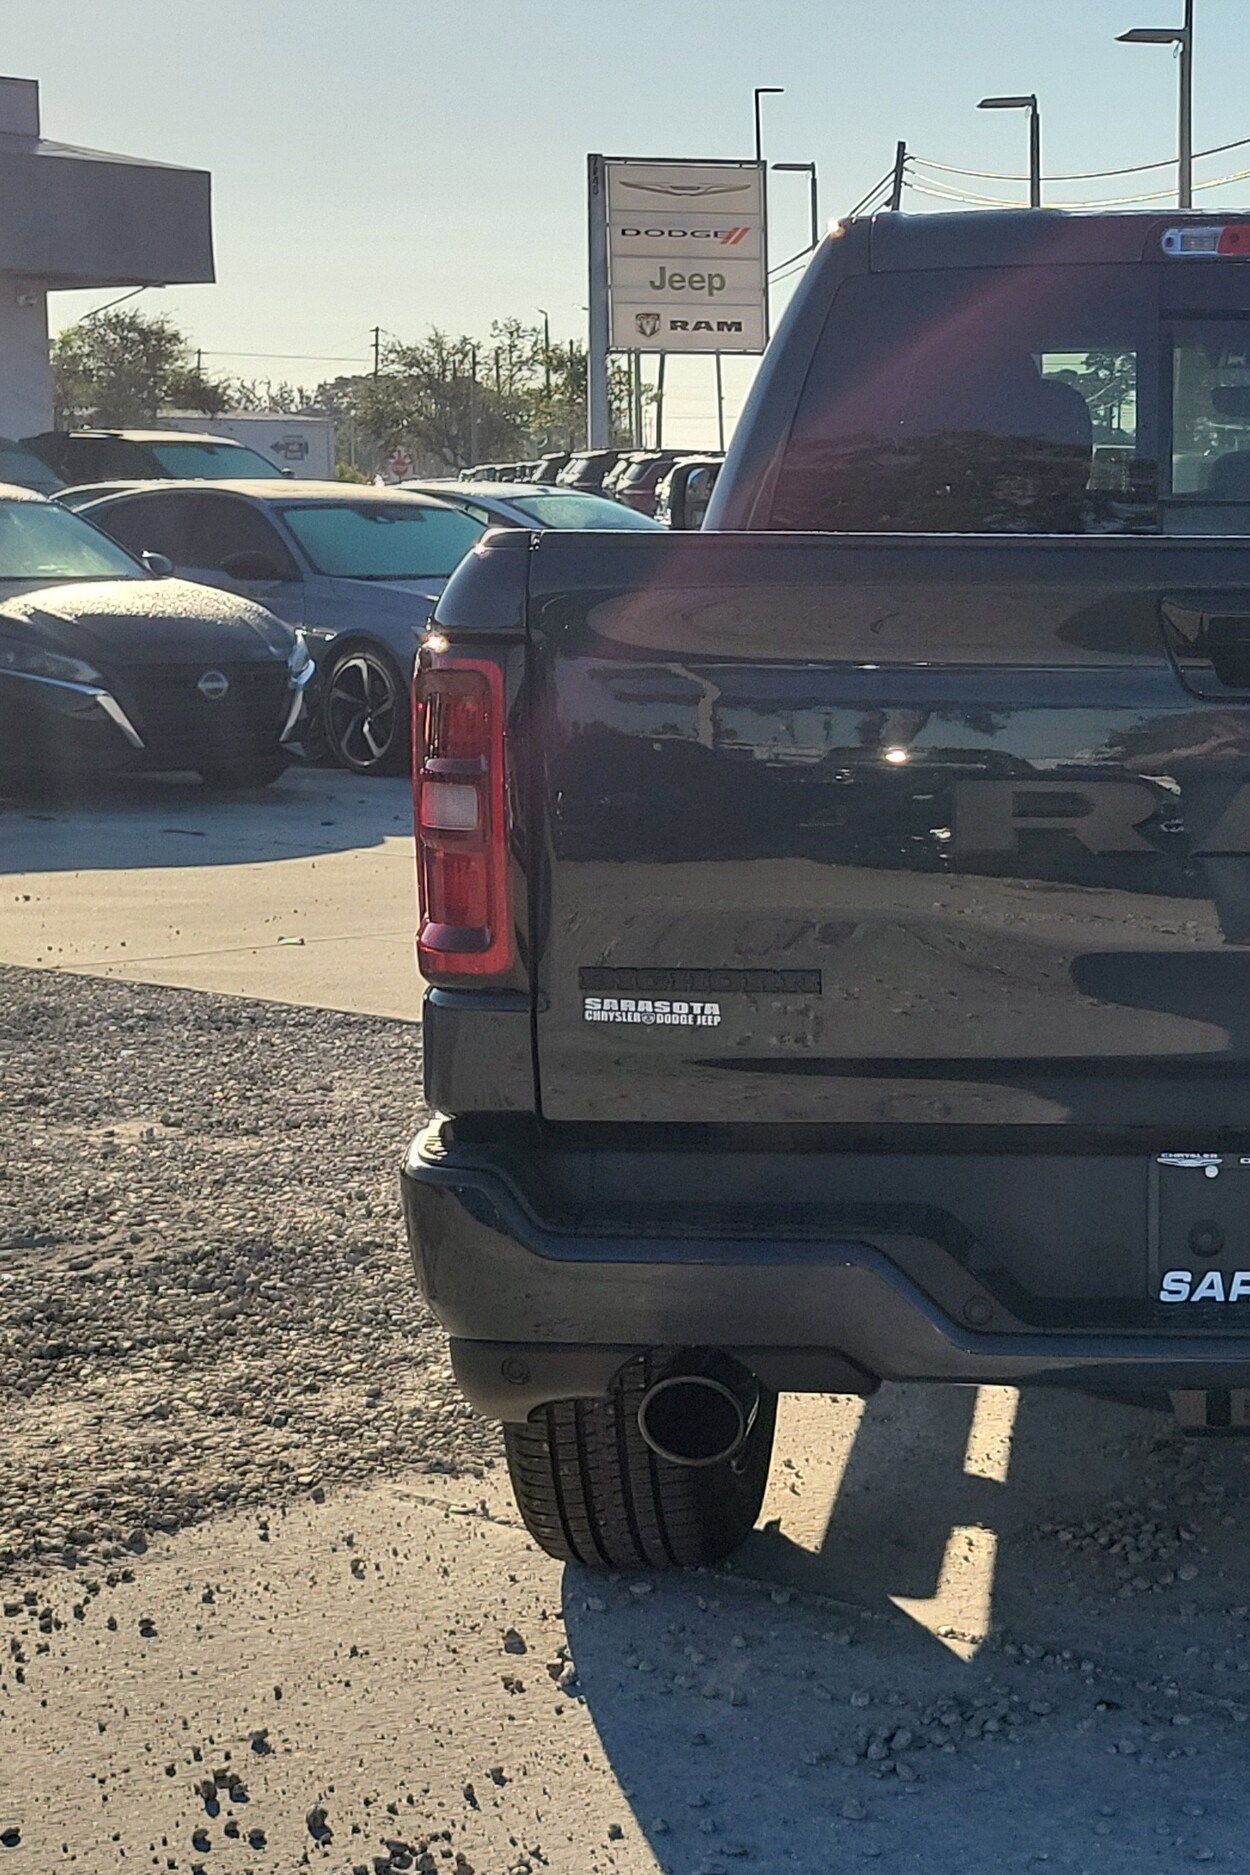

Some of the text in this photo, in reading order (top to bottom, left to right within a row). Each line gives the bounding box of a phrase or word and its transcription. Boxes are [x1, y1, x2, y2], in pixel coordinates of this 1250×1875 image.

[621, 228, 731, 239] DODGE
[649, 266, 727, 297] Jeep
[669, 319, 743, 333] RAM
[584, 997, 721, 1015] SARASOTA
[584, 1010, 721, 1026] CHRYSLER DODGE JEEP
